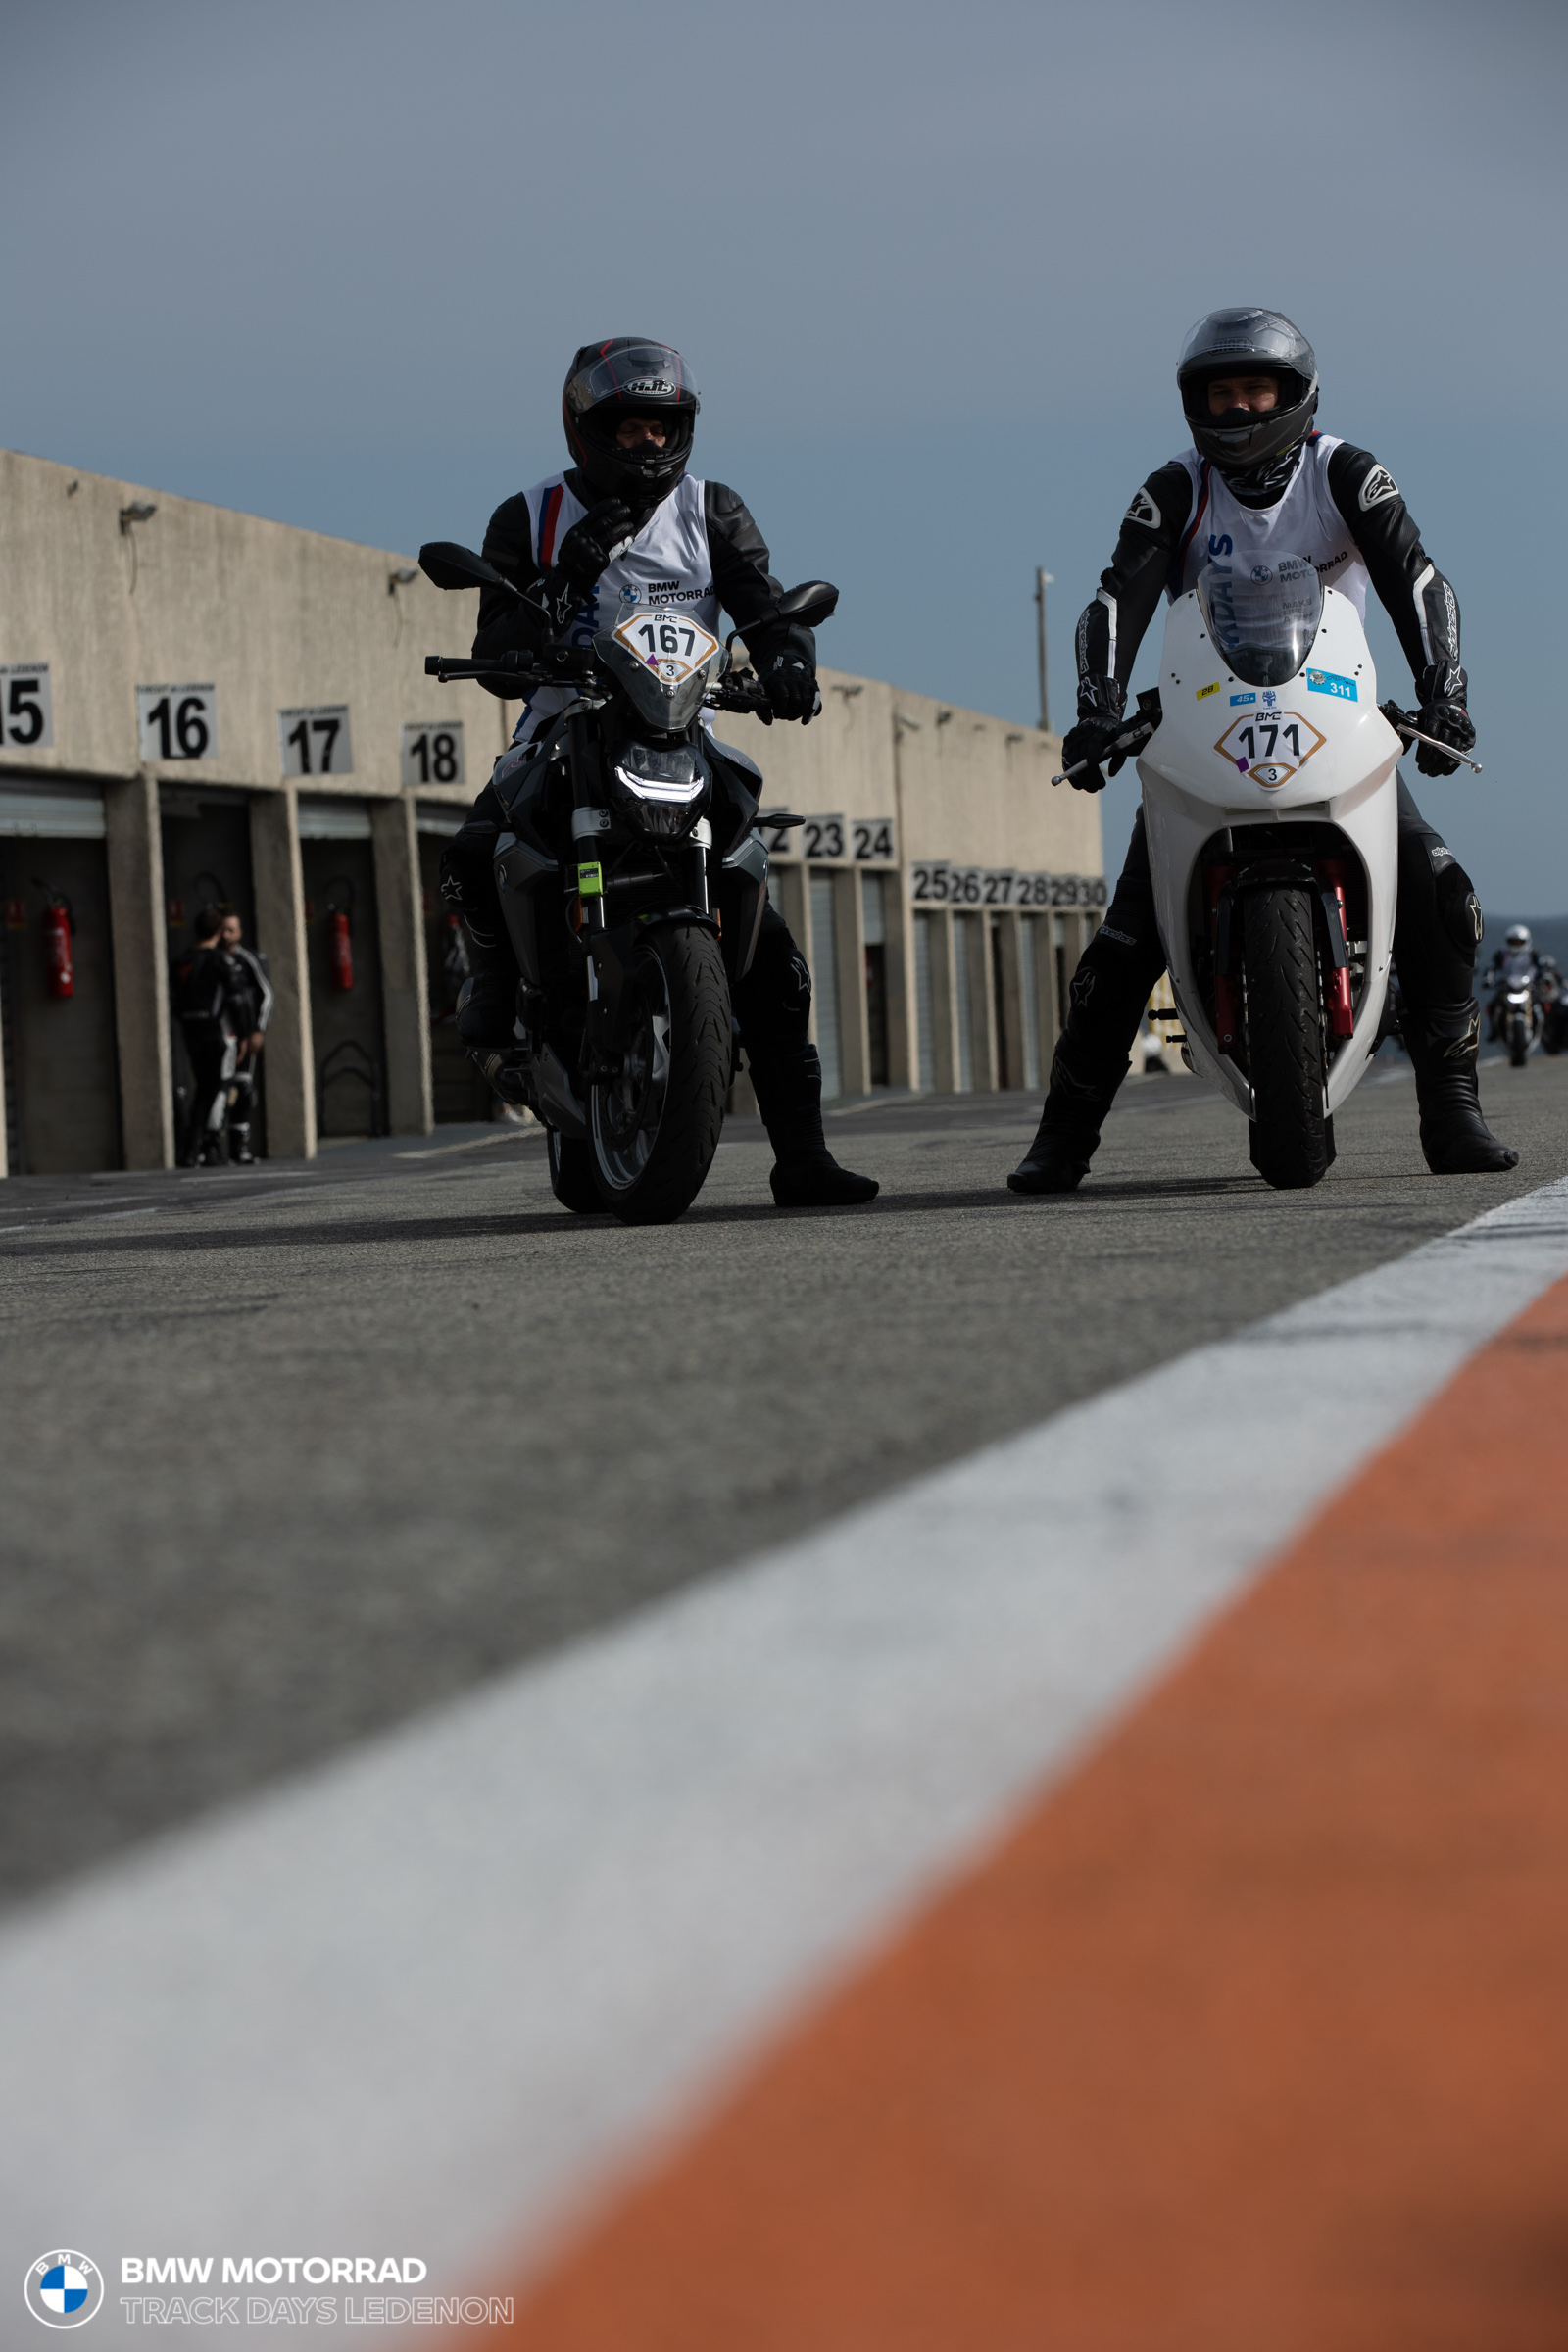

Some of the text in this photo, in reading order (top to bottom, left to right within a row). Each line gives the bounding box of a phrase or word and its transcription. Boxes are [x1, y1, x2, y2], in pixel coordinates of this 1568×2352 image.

[630, 379, 670, 392] HJC
[1277, 555, 1312, 572] BMW
[1280, 551, 1348, 583] MOTORRAD
[647, 580, 680, 593] BMW
[654, 614, 678, 624] BMC
[638, 624, 696, 657] 167
[666, 664, 675, 677] 3
[1201, 685, 1214, 696] 28
[1330, 681, 1351, 698] 311
[0, 679, 44, 745] 5
[1255, 711, 1282, 722] BMC
[148, 697, 209, 759] 16
[1238, 723, 1300, 759] 171
[288, 718, 341, 774] 17
[410, 732, 459, 784] 18
[1267, 768, 1278, 781] 3
[760, 827, 789, 853] 2
[804, 823, 843, 858] 23
[853, 826, 892, 860] 24
[913, 868, 949, 901] 25
[949, 873, 981, 904] 26
[984, 875, 1013, 904] 27
[1018, 878, 1048, 906] 28
[1051, 880, 1078, 906] 29
[1079, 879, 1107, 906] 30
